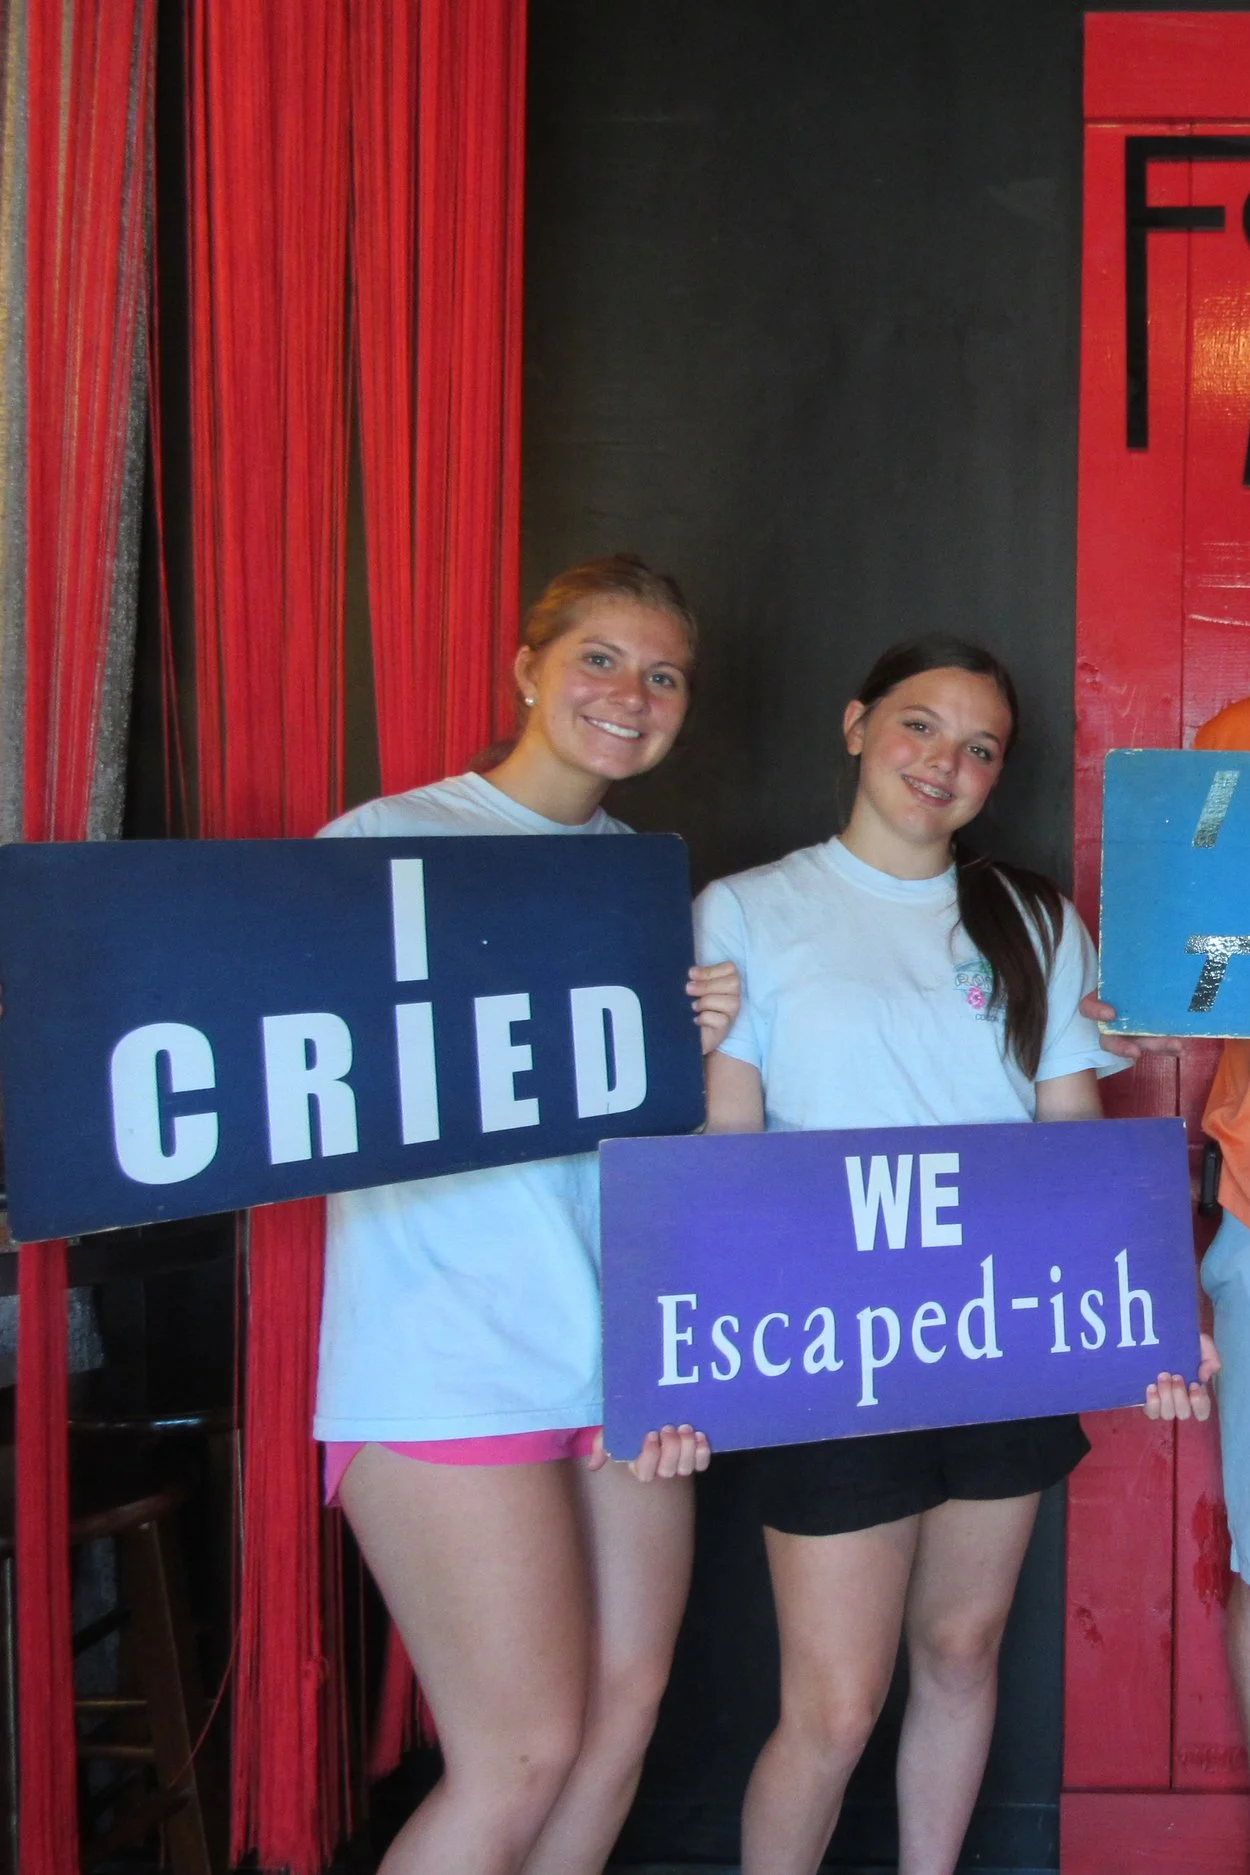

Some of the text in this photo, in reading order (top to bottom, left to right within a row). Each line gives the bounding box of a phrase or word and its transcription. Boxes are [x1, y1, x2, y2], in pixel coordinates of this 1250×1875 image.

[1191, 769, 1240, 850] I
[390, 858, 429, 982] I
[110, 985, 648, 1186] CRIED
[844, 1152, 963, 1252] WE
[656, 1248, 1160, 1408] Escaped-ish
